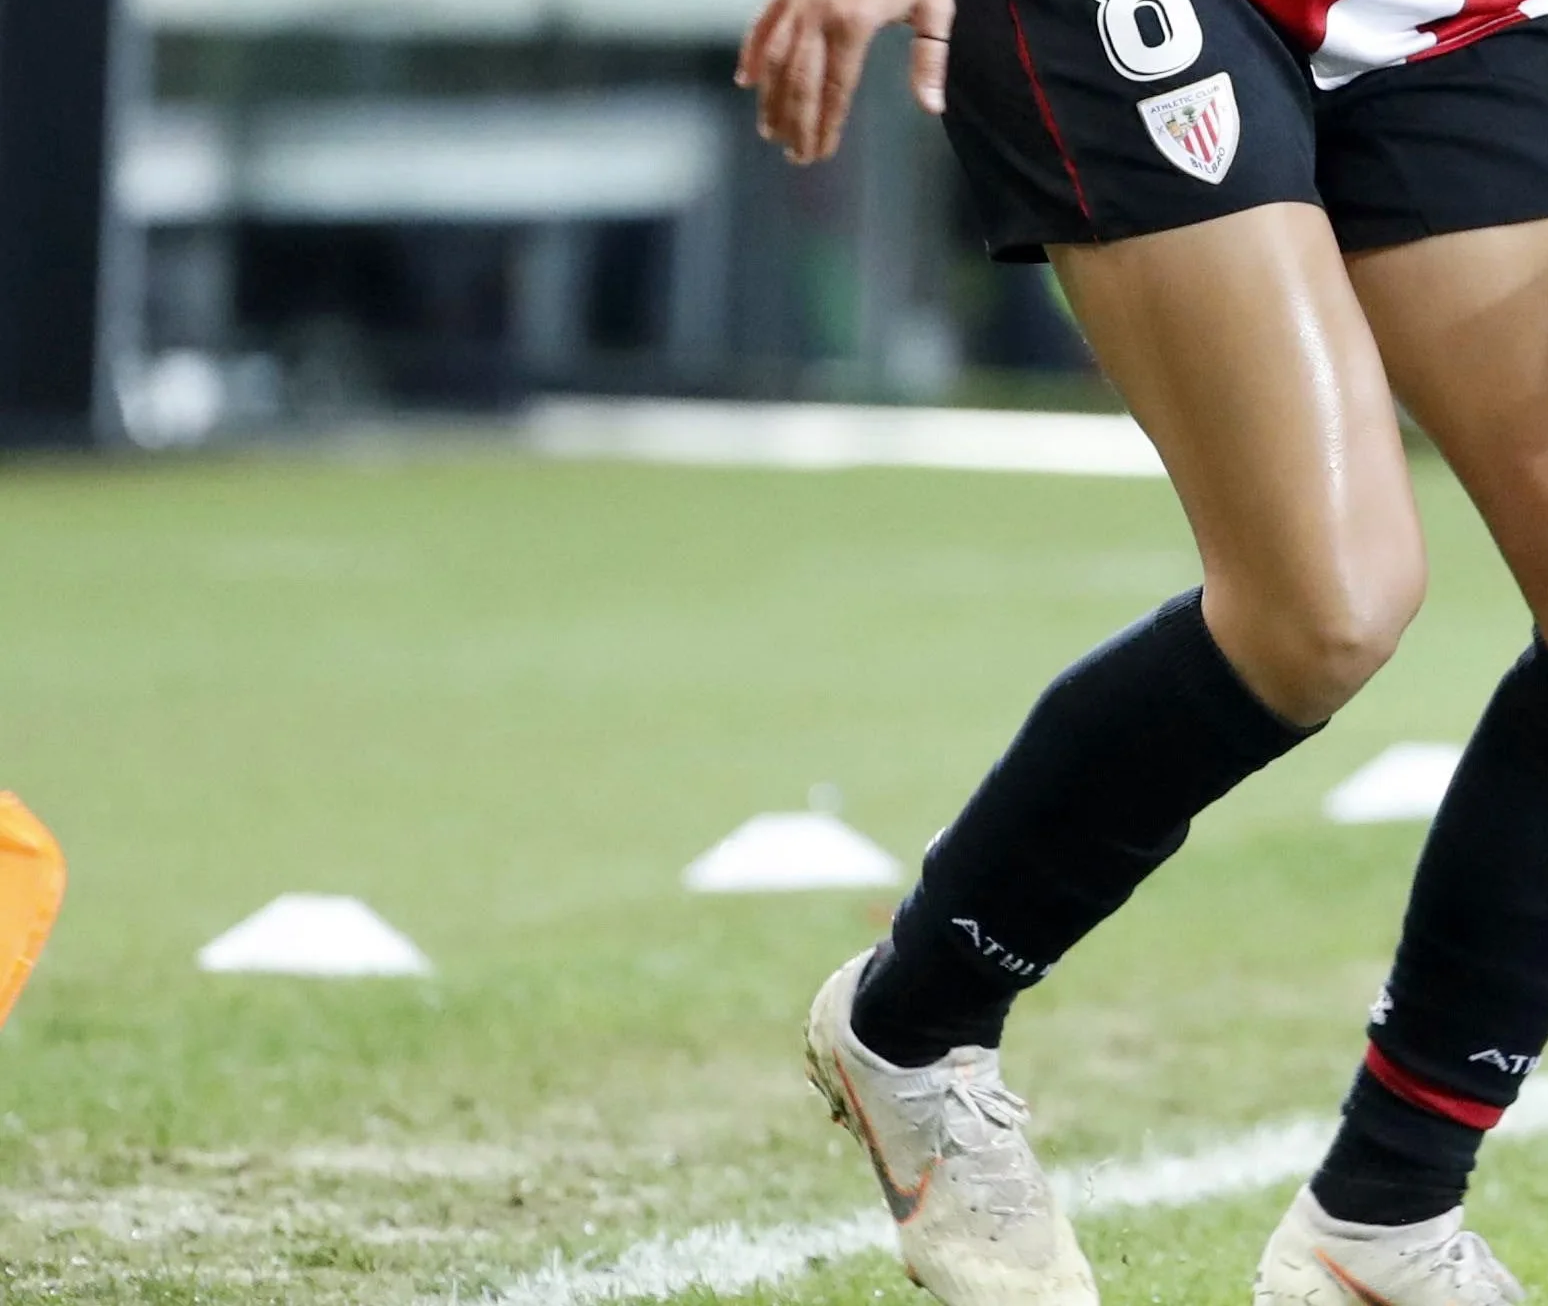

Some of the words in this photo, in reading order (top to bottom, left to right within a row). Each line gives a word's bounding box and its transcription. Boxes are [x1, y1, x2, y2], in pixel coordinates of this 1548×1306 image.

[1150, 94, 1194, 114] ATHLETIC
[1195, 85, 1220, 99] CLUB
[1189, 147, 1226, 174] BILBAO
